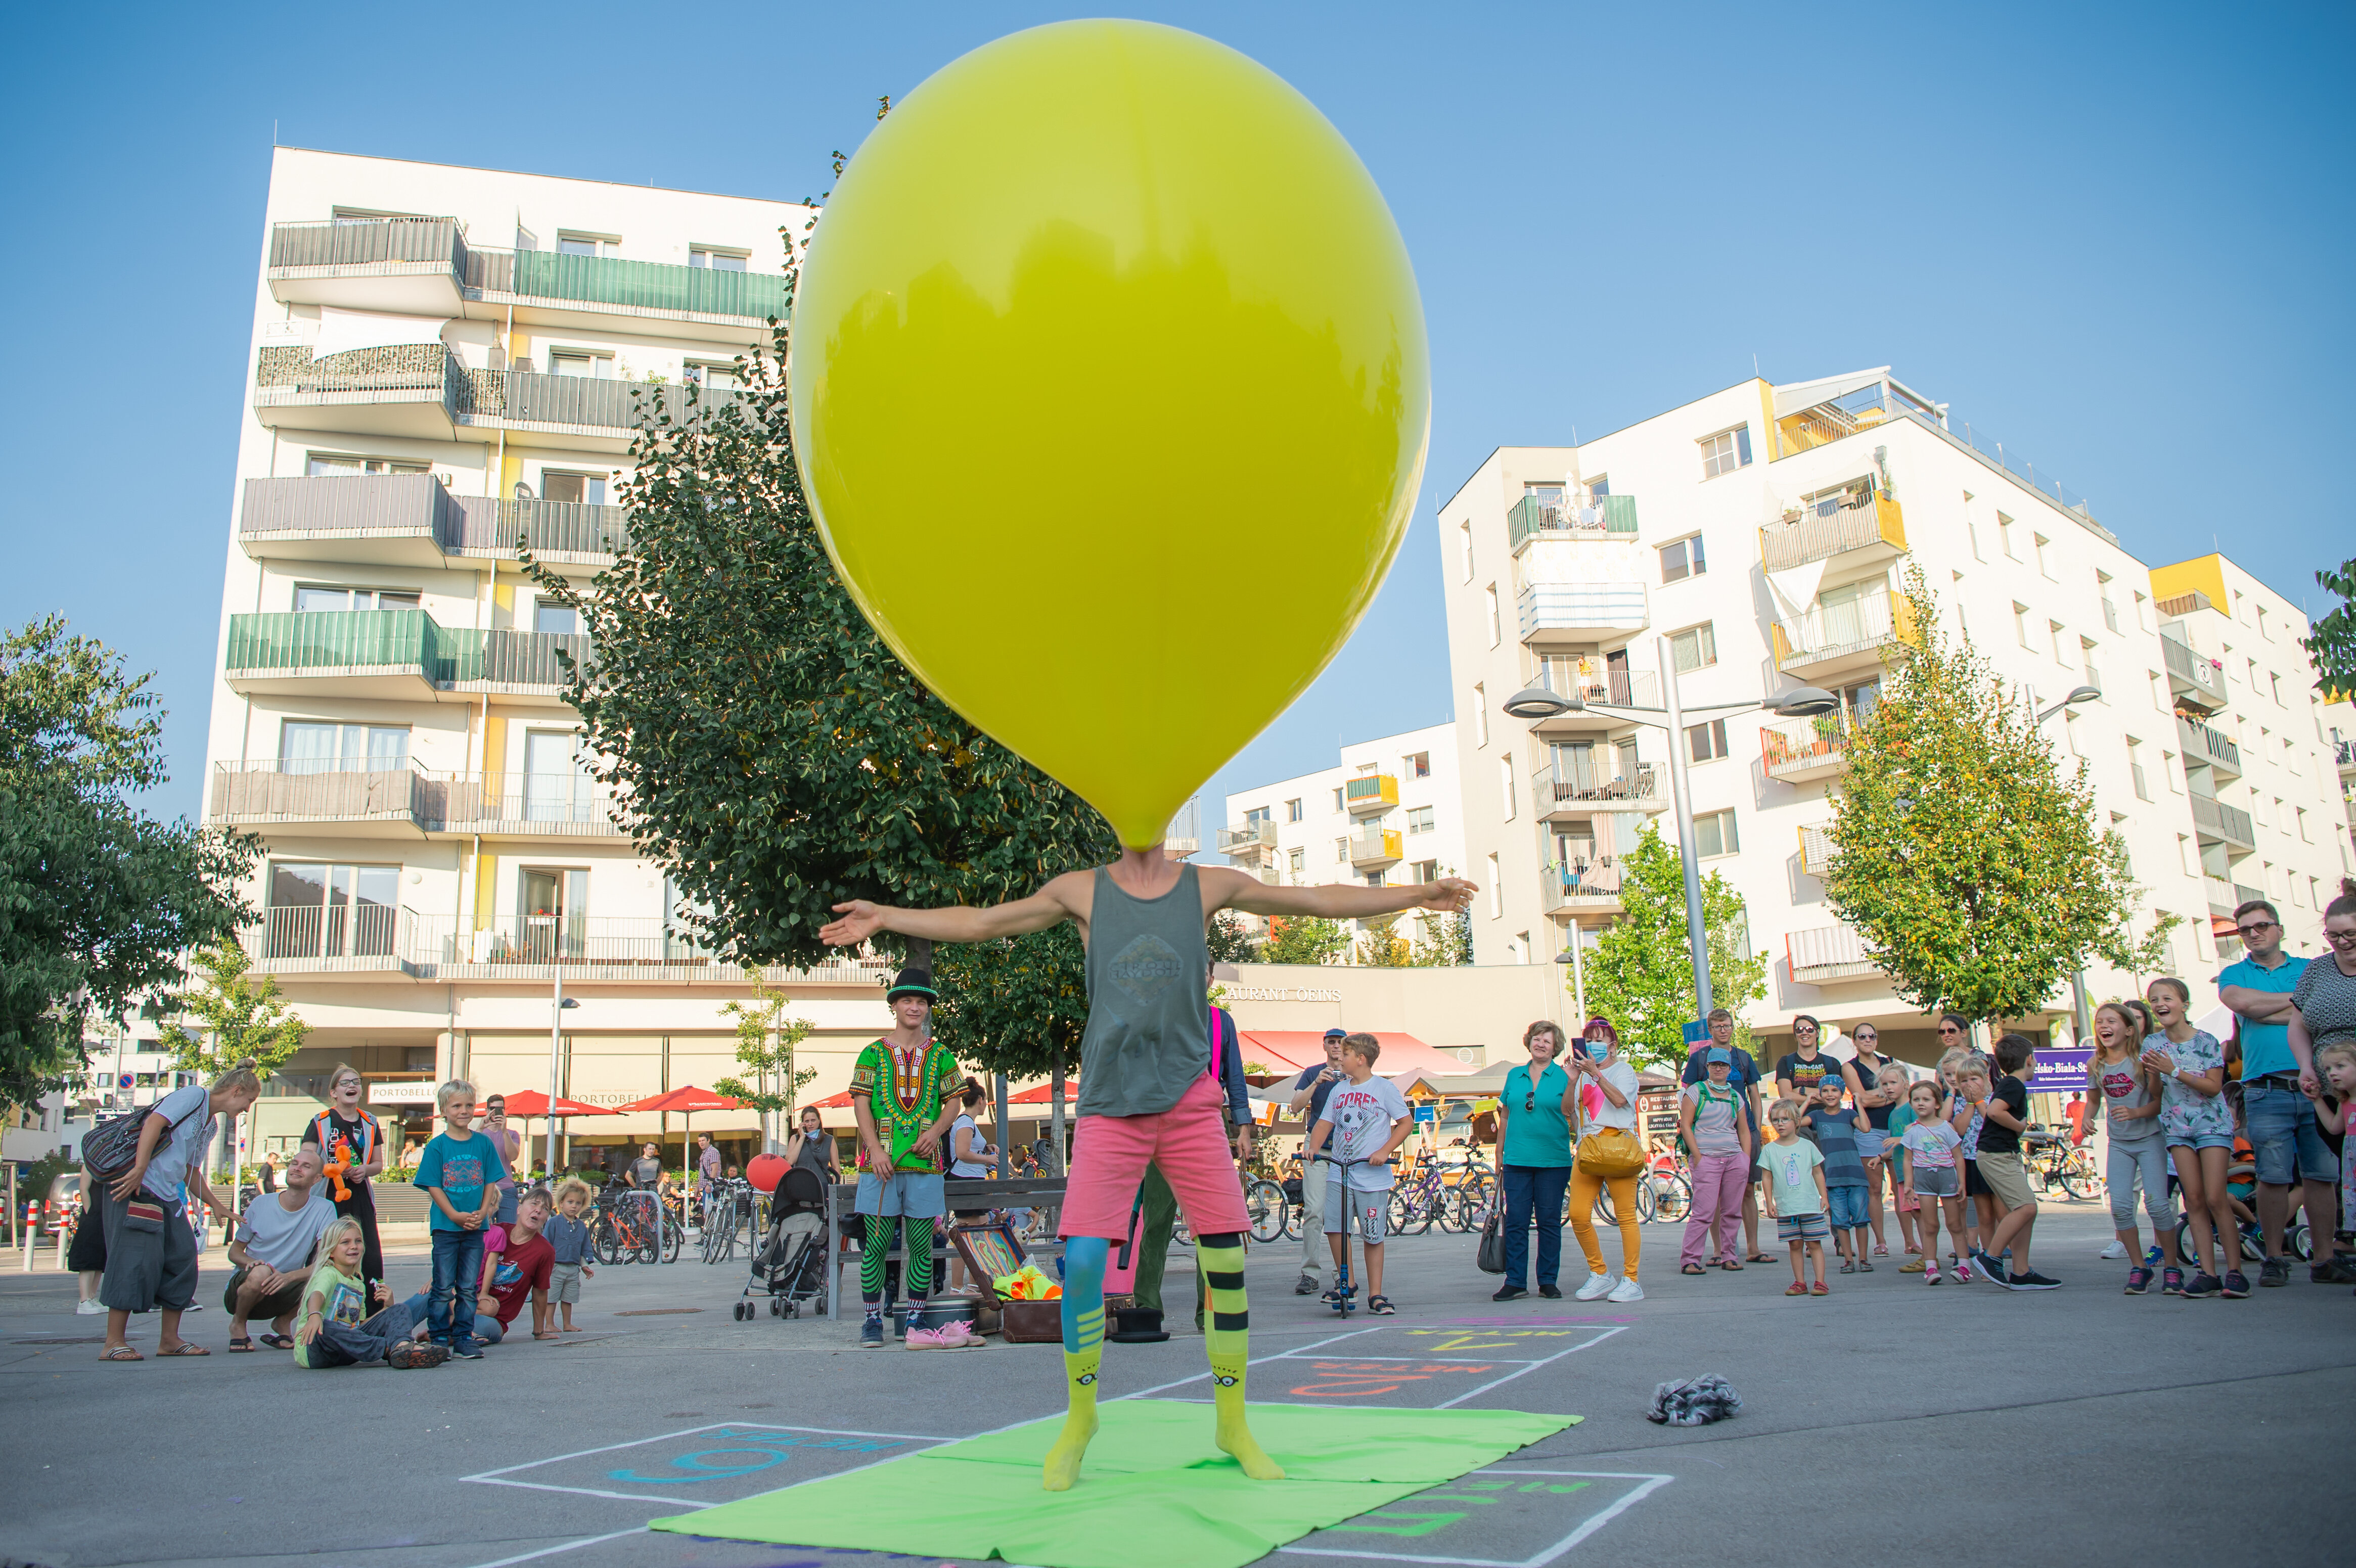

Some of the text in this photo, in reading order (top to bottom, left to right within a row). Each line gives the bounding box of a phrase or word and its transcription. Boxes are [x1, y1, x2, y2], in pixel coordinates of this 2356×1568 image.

[1211, 987, 1341, 1002] TAURANT ÖEINS
[2033, 1062, 2088, 1074] elsko-Biala-St
[571, 1094, 658, 1103] PORTOBEL
[1311, 1362, 1493, 1373] METER
[1290, 1373, 1431, 1397] 2
[699, 1428, 905, 1453] METER
